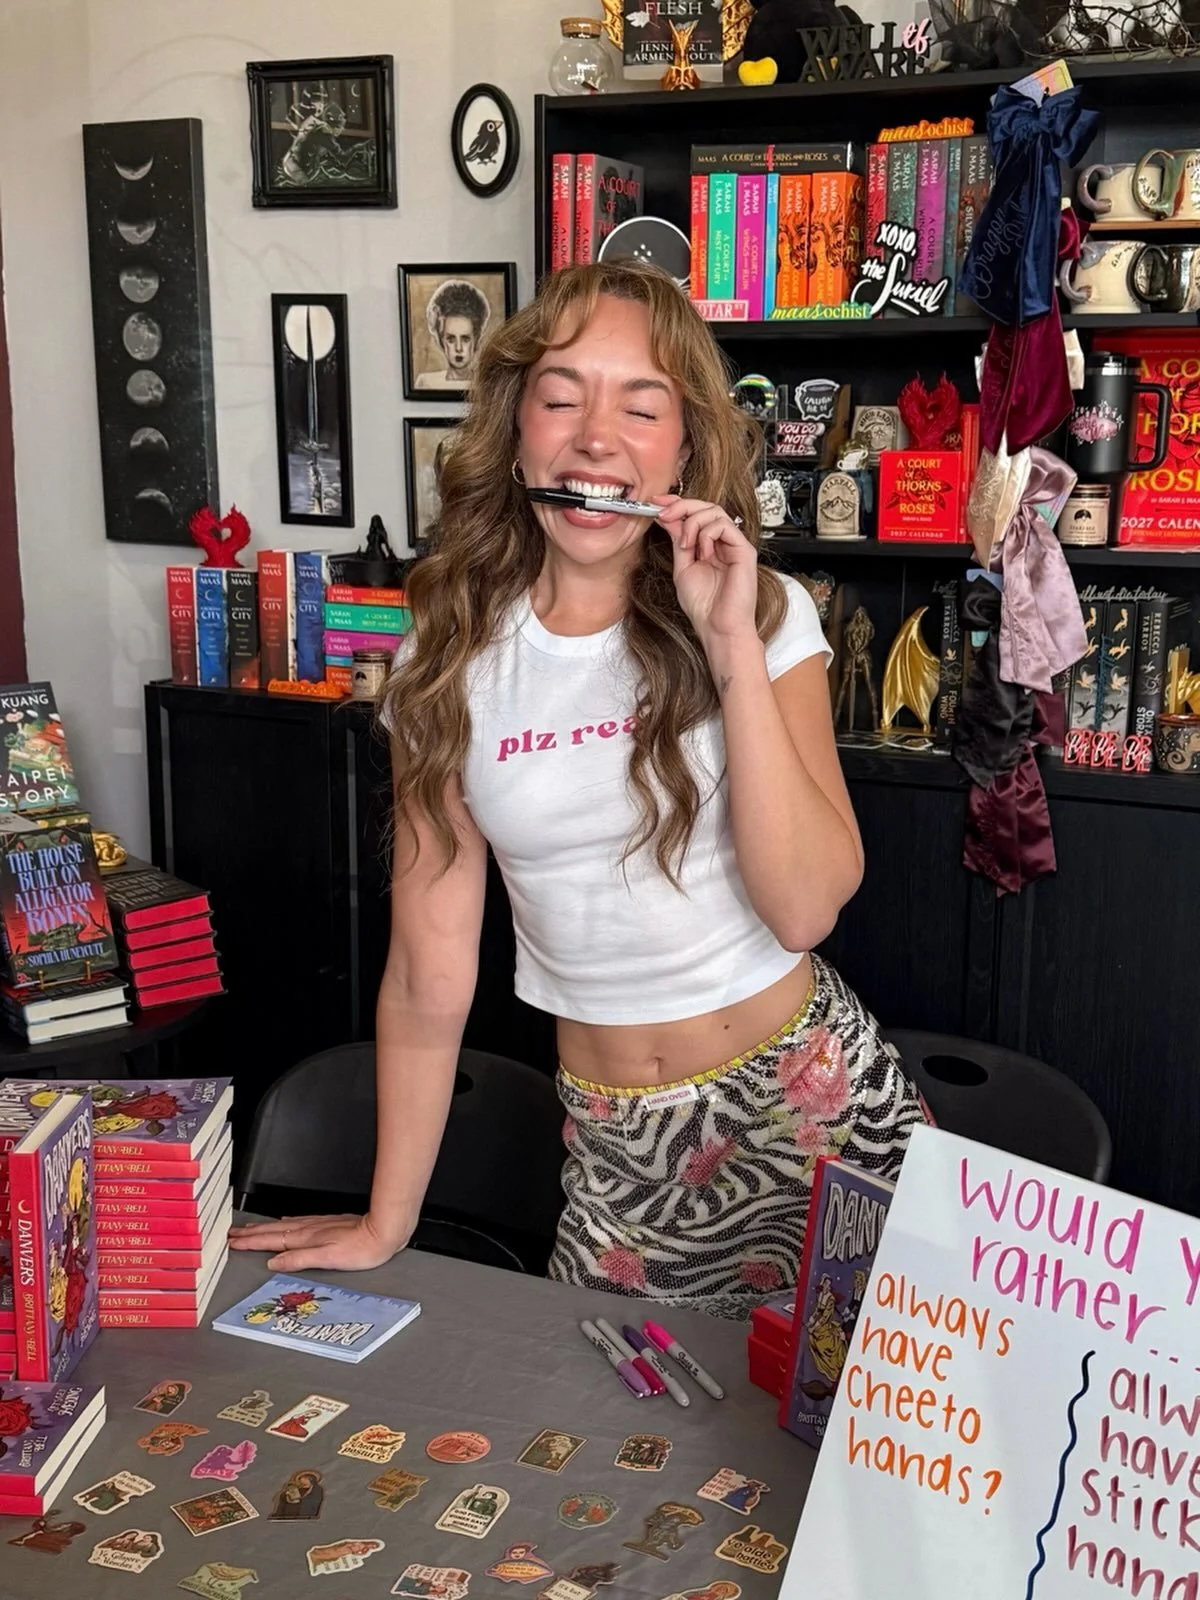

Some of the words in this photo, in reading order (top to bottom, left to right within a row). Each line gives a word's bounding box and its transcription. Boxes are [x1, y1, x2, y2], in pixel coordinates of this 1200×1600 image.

[645, 2, 703, 16] FLESH
[799, 50, 931, 83] AWARE
[930, 149, 939, 184] SARAH
[968, 154, 977, 185] MAAS
[978, 145, 987, 180] SARAH
[608, 177, 641, 199] COURT
[860, 257, 887, 280] the
[771, 302, 868, 320] maasochist
[777, 423, 800, 434] YOU
[800, 423, 817, 433] DO
[784, 434, 807, 444] NOT
[896, 458, 905, 468] A
[908, 459, 942, 469] COURT
[896, 480, 942, 491] THORNS
[1130, 468, 1200, 492] ROS
[899, 503, 937, 515] ROSES
[1120, 517, 1154, 529] 2027
[1158, 518, 1200, 530] CALEN
[1, 693, 49, 709] KUANG
[496, 728, 557, 762] plz
[570, 714, 640, 746] rea
[0, 766, 67, 788] AIPEI
[6, 851, 34, 874] THE
[38, 843, 86, 868] HOUSE
[18, 866, 58, 892] BUILT
[60, 863, 82, 884] ON
[15, 881, 96, 914] ALLIGATOR
[44, 1107, 92, 1231] DANVERS
[17, 1217, 36, 1287] DANVERS
[876, 1272, 1015, 1357] always
[270, 1316, 375, 1348] DANVERS
[861, 1316, 954, 1382] have
[198, 1466, 228, 1477] SLAY
